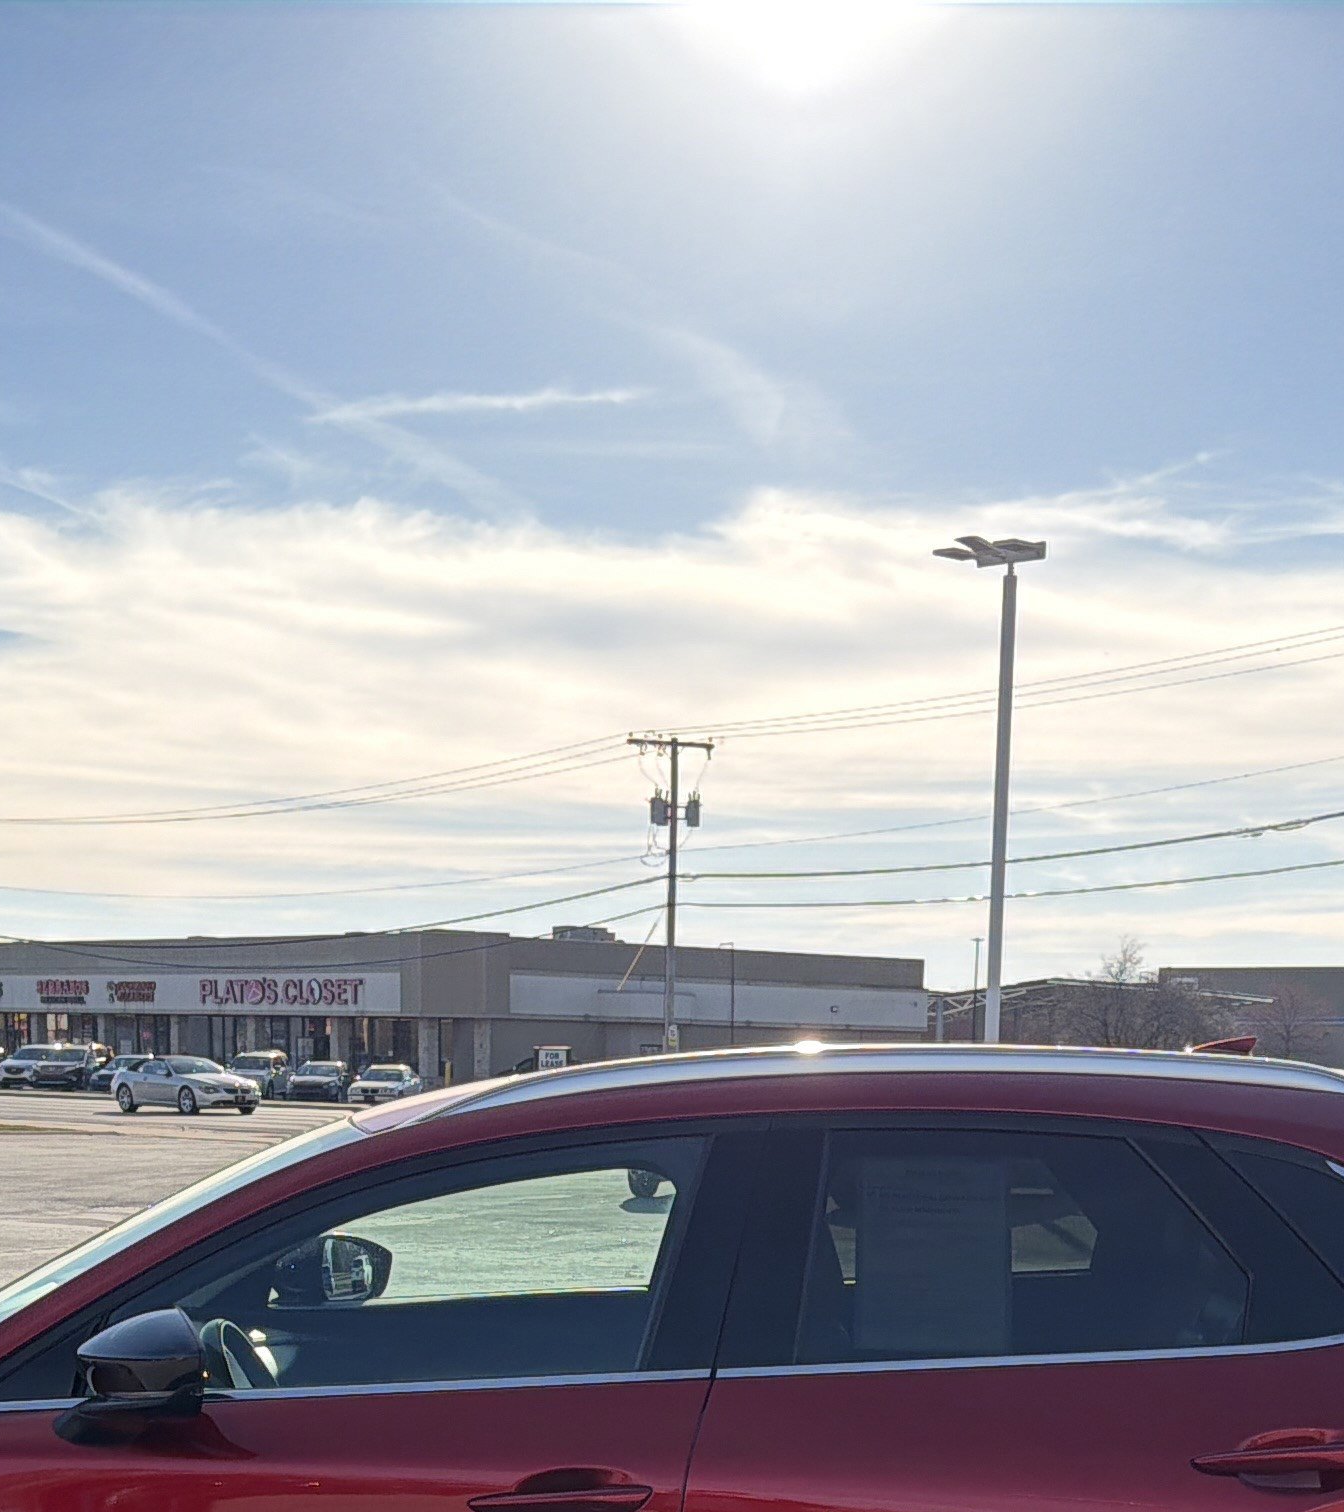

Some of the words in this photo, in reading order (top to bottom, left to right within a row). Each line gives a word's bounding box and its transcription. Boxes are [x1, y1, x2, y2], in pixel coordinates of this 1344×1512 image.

[199, 977, 278, 1006] PLATO'S
[282, 978, 365, 1006] CLOSET
[545, 1052, 560, 1060] FOR
[540, 1060, 564, 1068] LEASE
